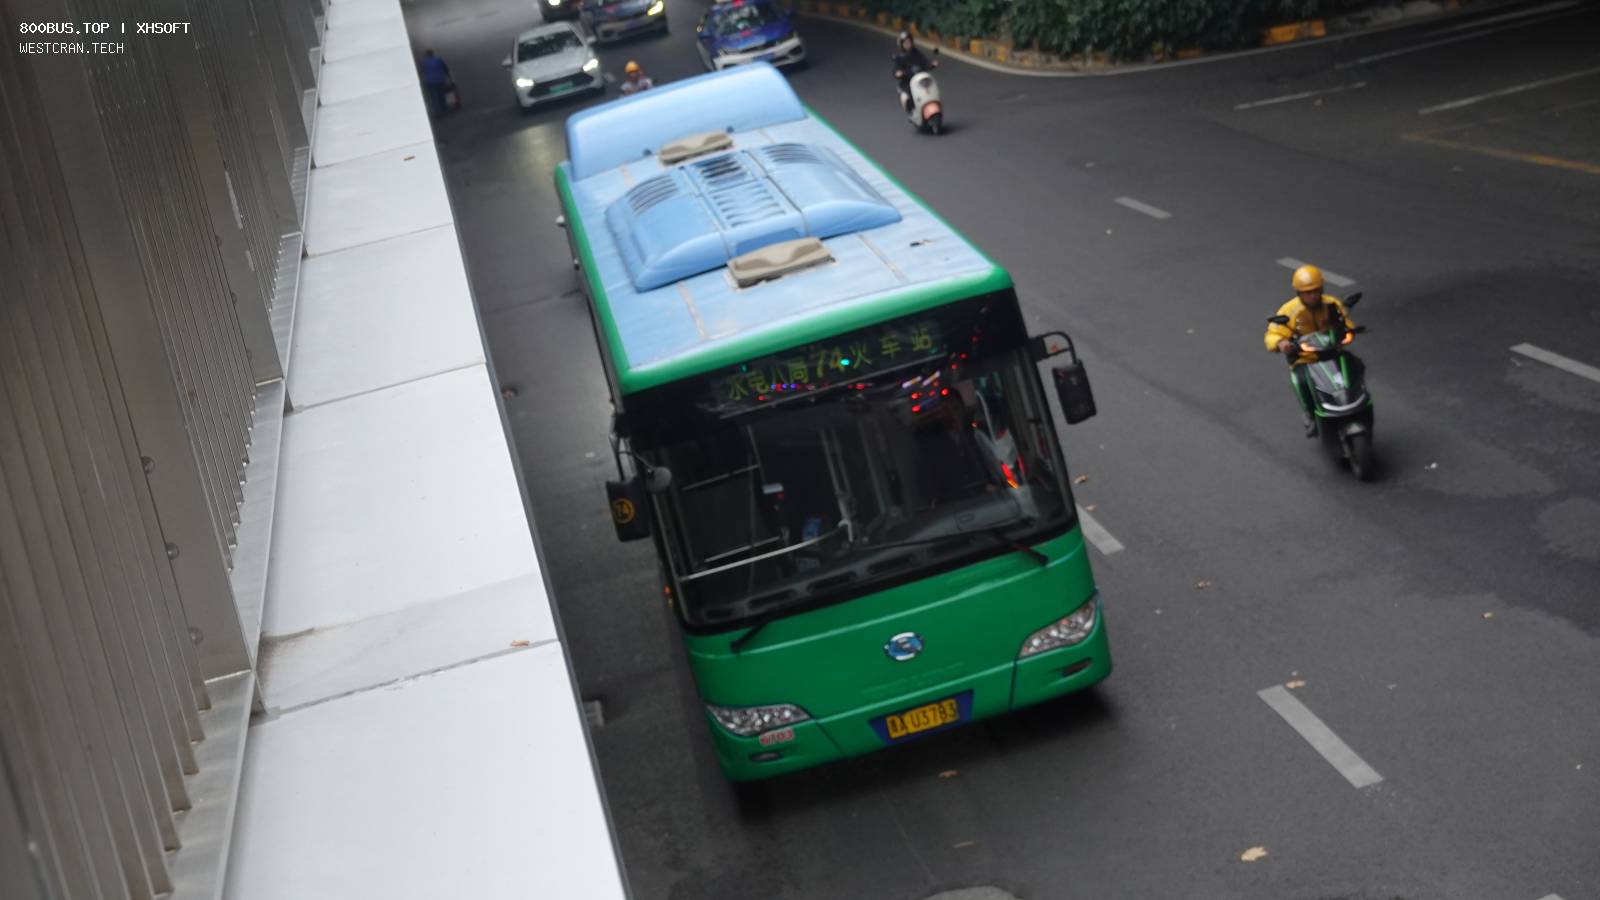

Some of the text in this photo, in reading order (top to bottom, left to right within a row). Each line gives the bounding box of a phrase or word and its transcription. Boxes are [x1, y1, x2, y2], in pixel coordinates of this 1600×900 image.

[814, 347, 848, 379] 74
[851, 329, 933, 369] 火车站
